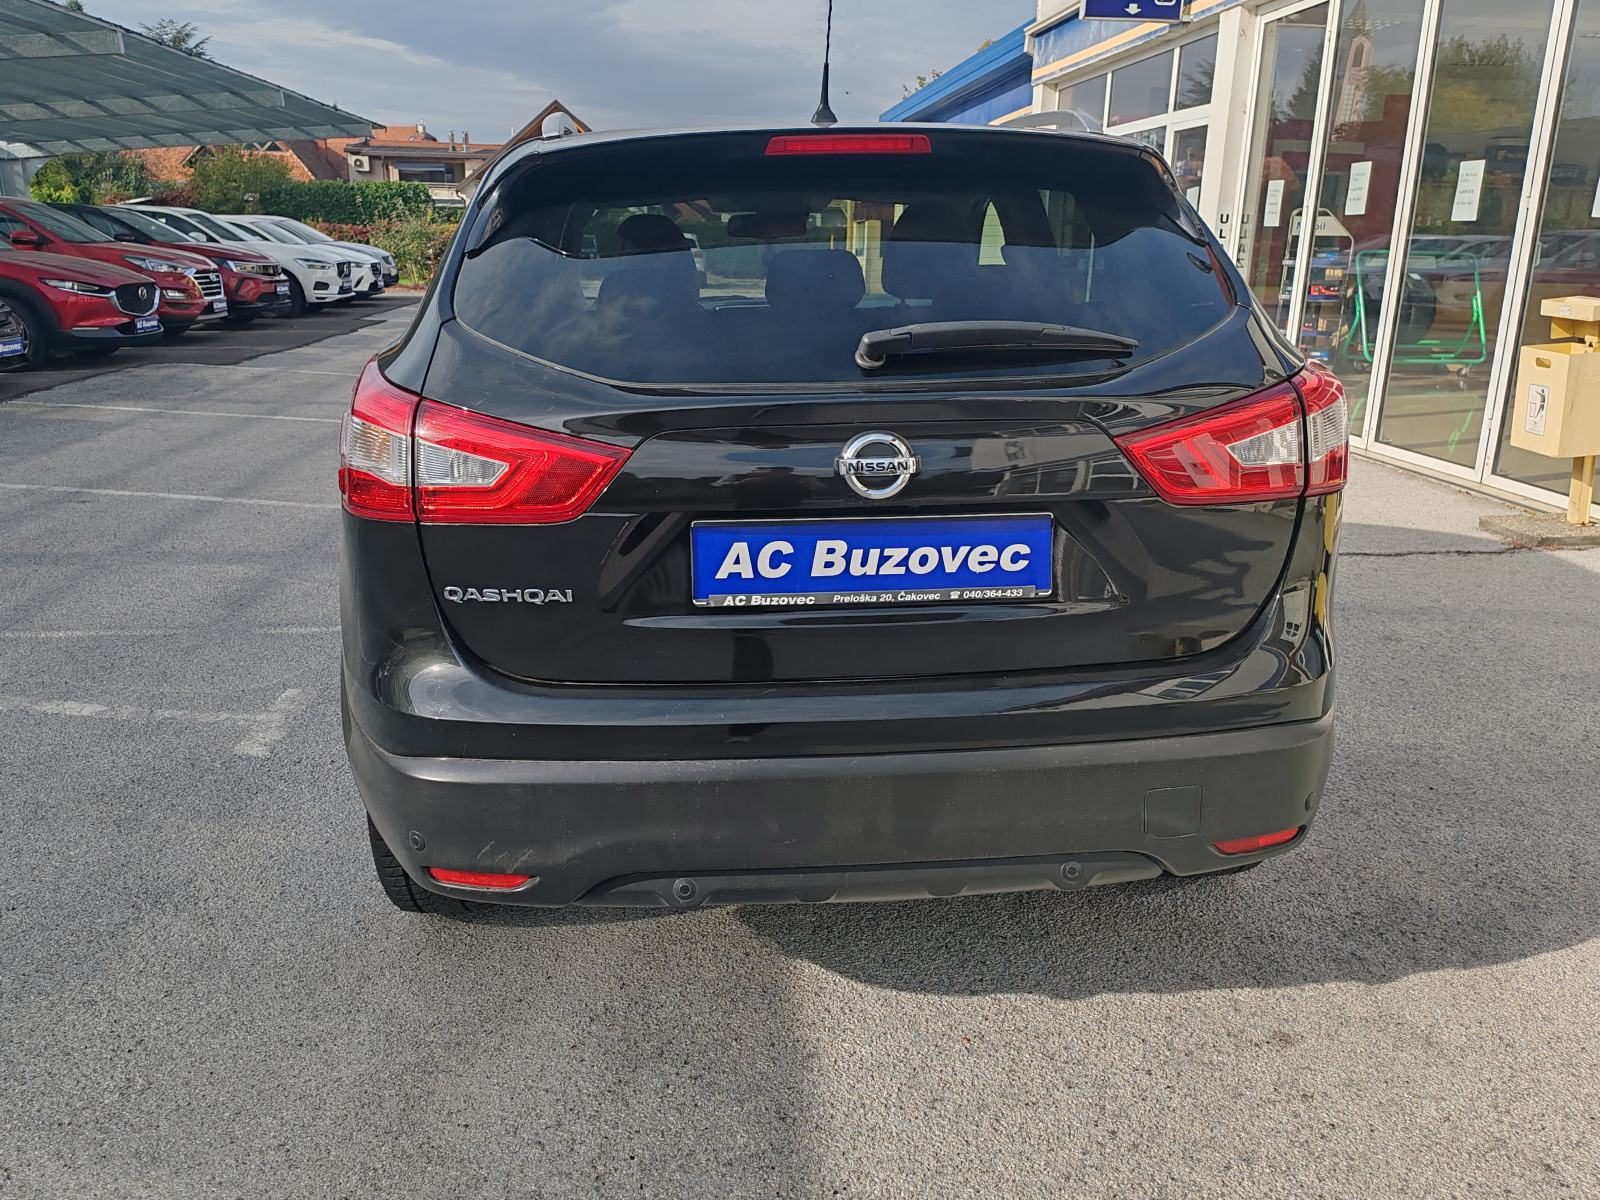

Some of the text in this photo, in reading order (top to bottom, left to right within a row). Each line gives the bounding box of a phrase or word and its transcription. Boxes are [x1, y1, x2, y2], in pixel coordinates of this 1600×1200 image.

[848, 461, 908, 472] NISSAN
[714, 539, 1031, 580] AC Buzovec
[443, 586, 573, 605] QASHQAI
[723, 588, 1023, 606] AC Buzovec Preloška 20, Čakovec 040/364-433
